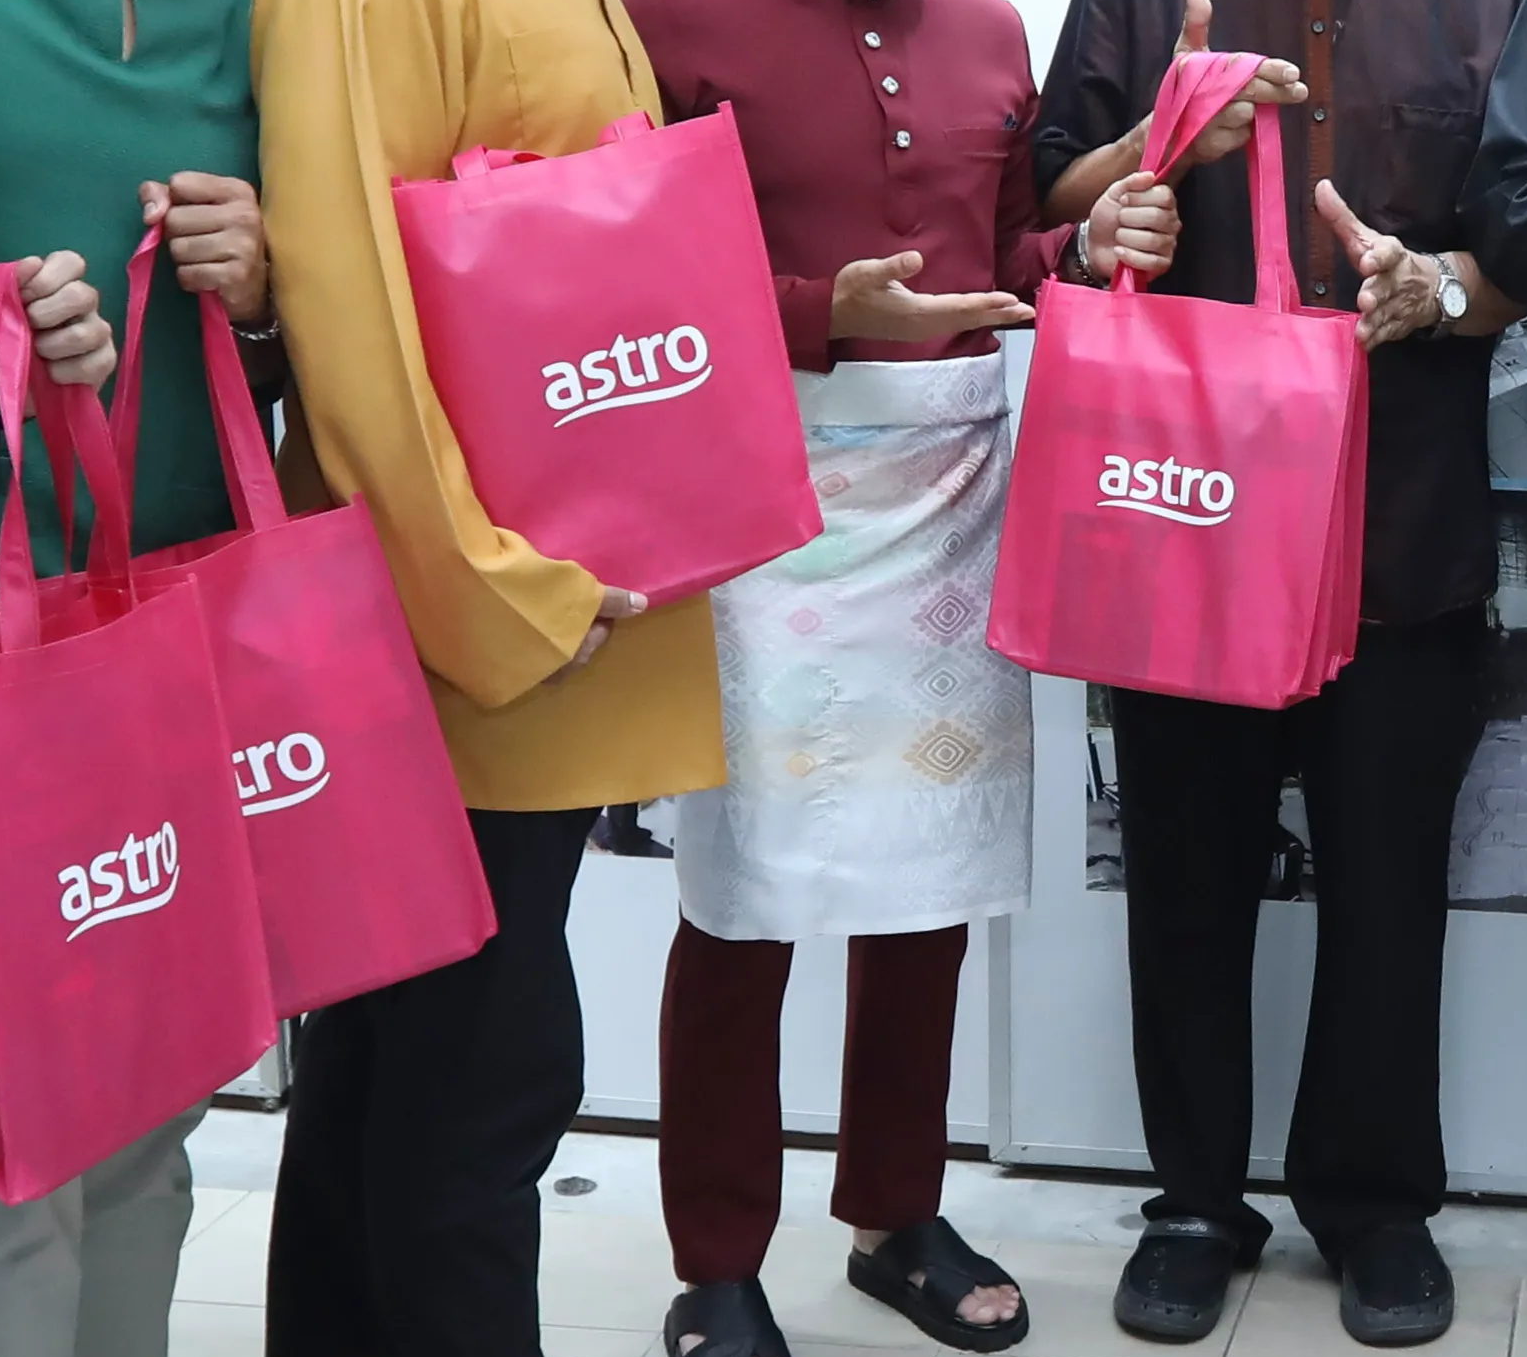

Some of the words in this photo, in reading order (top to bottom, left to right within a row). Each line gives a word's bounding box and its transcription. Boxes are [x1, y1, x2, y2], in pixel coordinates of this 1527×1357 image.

[541, 325, 708, 410] astro
[1098, 455, 1235, 512] astro
[58, 821, 177, 921] astro
